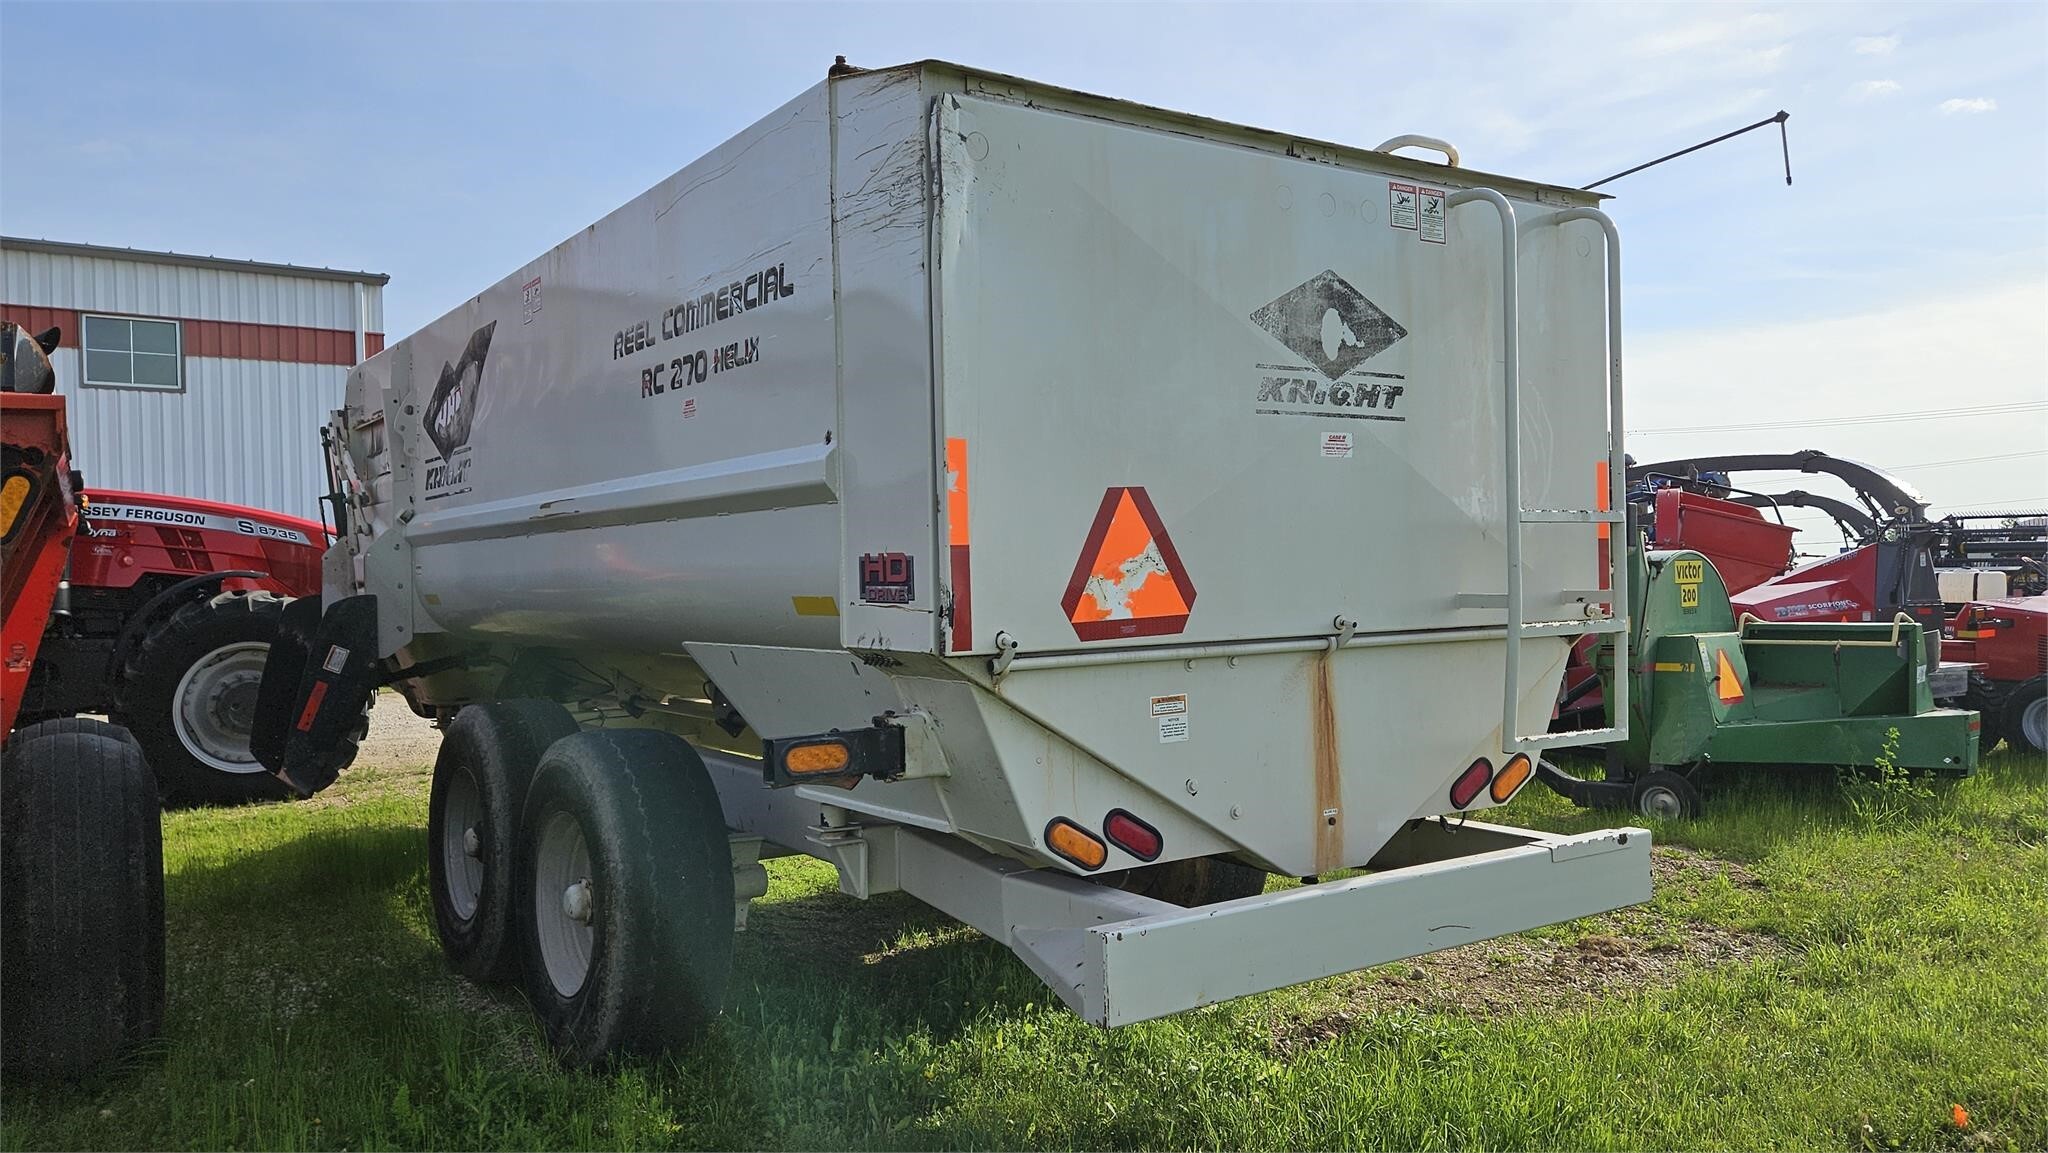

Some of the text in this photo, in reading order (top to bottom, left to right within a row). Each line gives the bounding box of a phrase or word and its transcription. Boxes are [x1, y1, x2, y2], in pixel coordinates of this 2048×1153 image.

[613, 262, 794, 360] REEL COMMERCIAL
[641, 336, 760, 399] RC 270 HELIX
[1256, 376, 1404, 409] KNIGHT
[83, 506, 298, 540] SSEY FERGUSON S 8735
[864, 552, 908, 584] HD
[868, 588, 908, 601] DRIVE
[1682, 588, 1697, 602] 200
